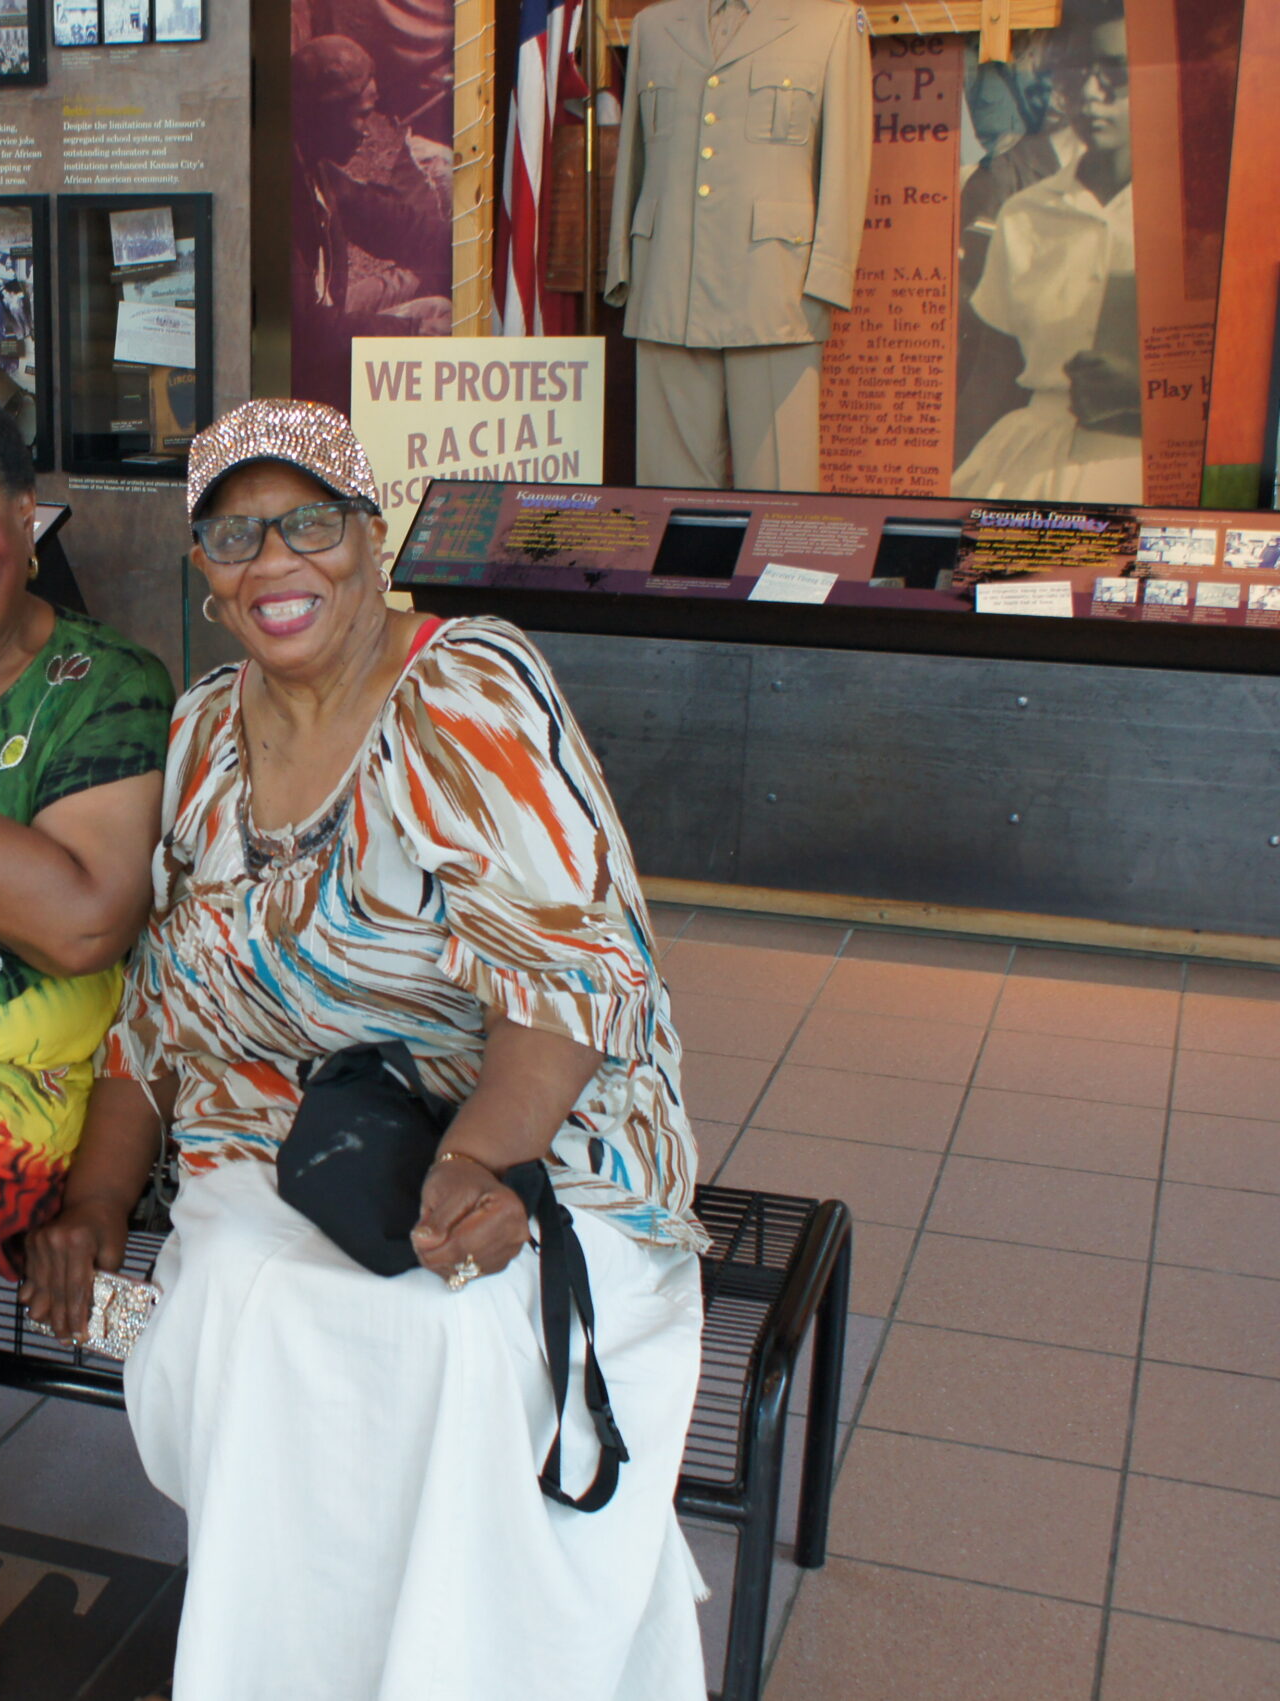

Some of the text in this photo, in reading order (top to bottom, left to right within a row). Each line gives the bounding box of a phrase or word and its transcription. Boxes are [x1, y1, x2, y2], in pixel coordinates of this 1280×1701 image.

[890, 34, 944, 58] See
[872, 67, 943, 103] C. P.
[872, 113, 949, 144] Here
[874, 186, 948, 206] in Rec-
[856, 267, 946, 280] first N.A.A.
[891, 284, 946, 297] several
[889, 301, 946, 314] to the
[860, 320, 883, 331] the
[894, 319, 920, 331] line
[930, 319, 946, 331] of
[365, 361, 588, 401] WE PROTEST
[1147, 378, 1192, 401] Play
[408, 409, 562, 470] RACIAL
[375, 450, 579, 510] ISCINATION
[516, 490, 602, 505] Kansas City
[971, 508, 1088, 522] Strength from
[980, 517, 1110, 532] Community
